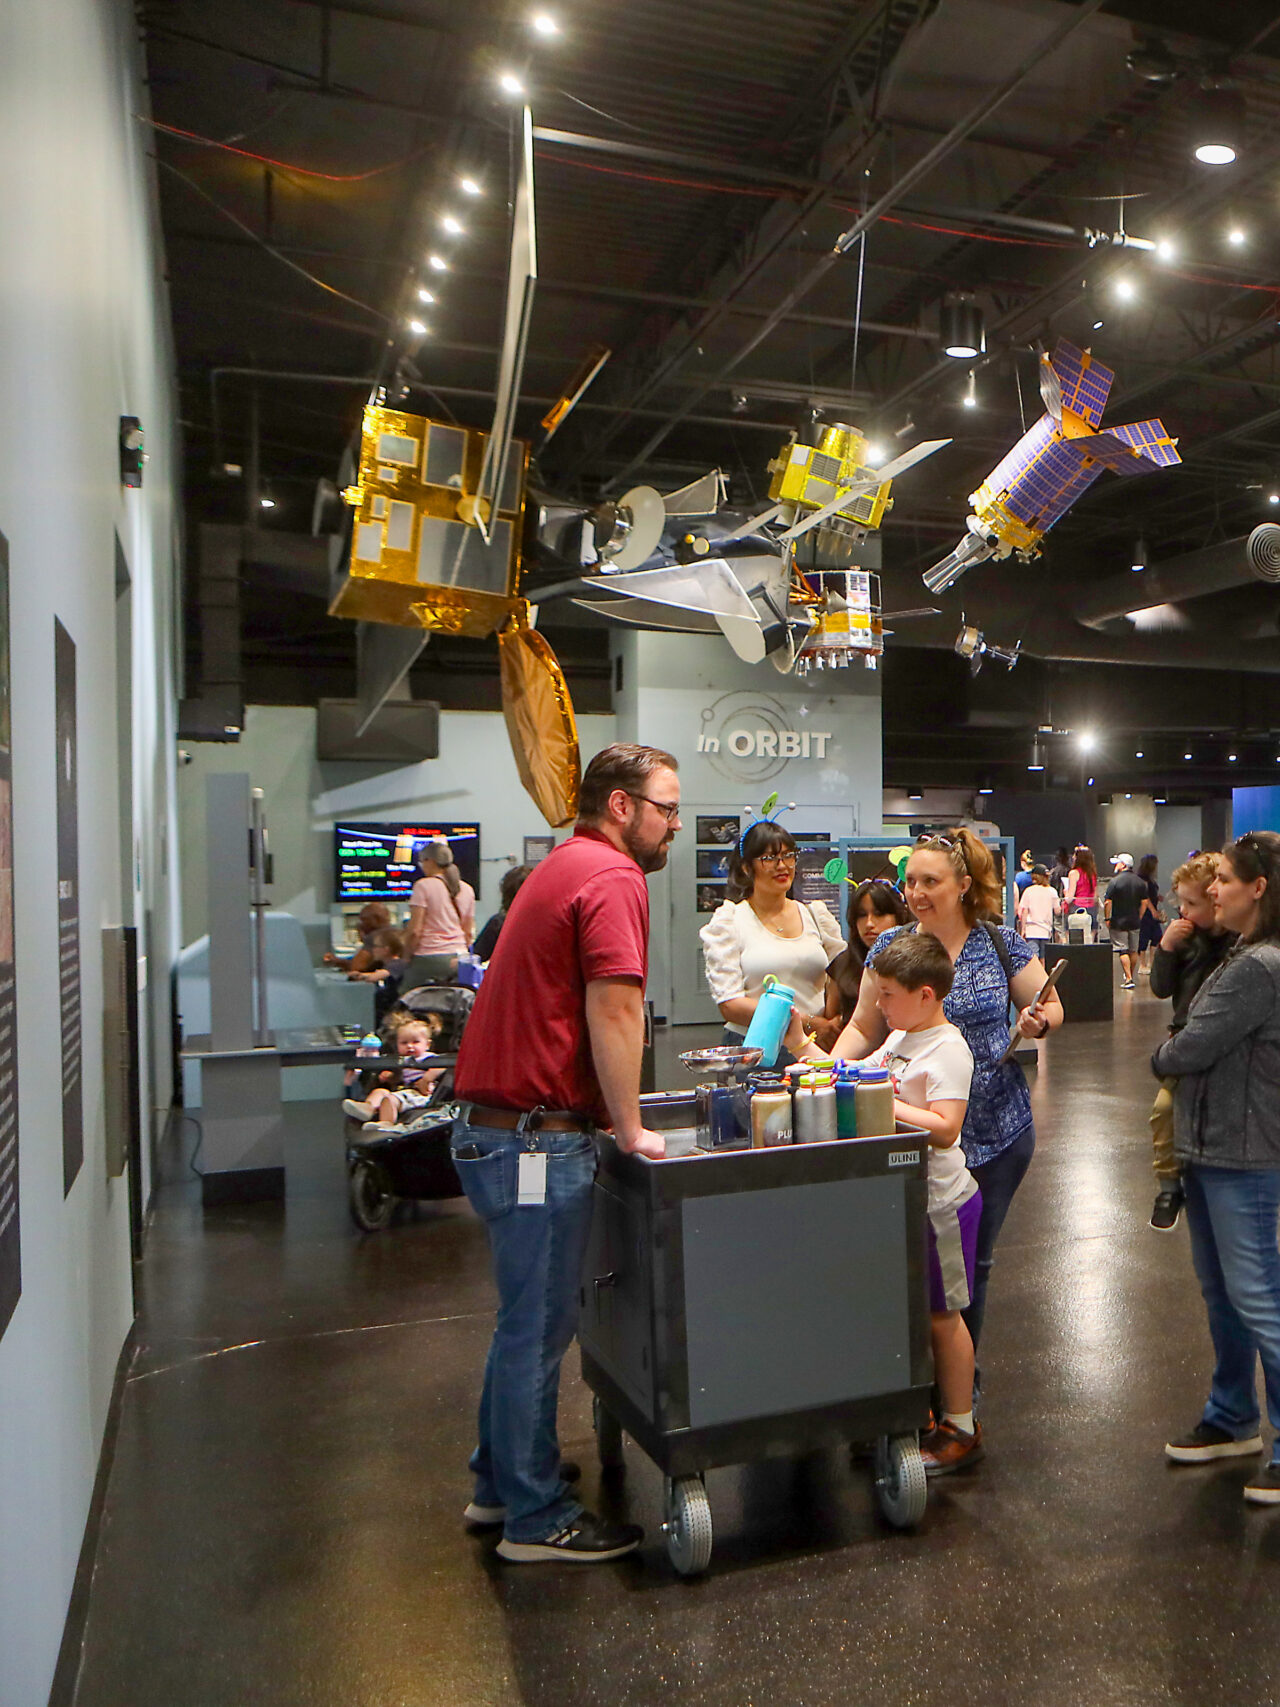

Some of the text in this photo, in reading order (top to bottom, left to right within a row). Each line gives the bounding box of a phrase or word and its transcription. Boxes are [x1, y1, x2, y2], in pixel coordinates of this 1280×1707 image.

[697, 730, 832, 759] In ORBIT
[891, 1152, 918, 1163] ULINE
